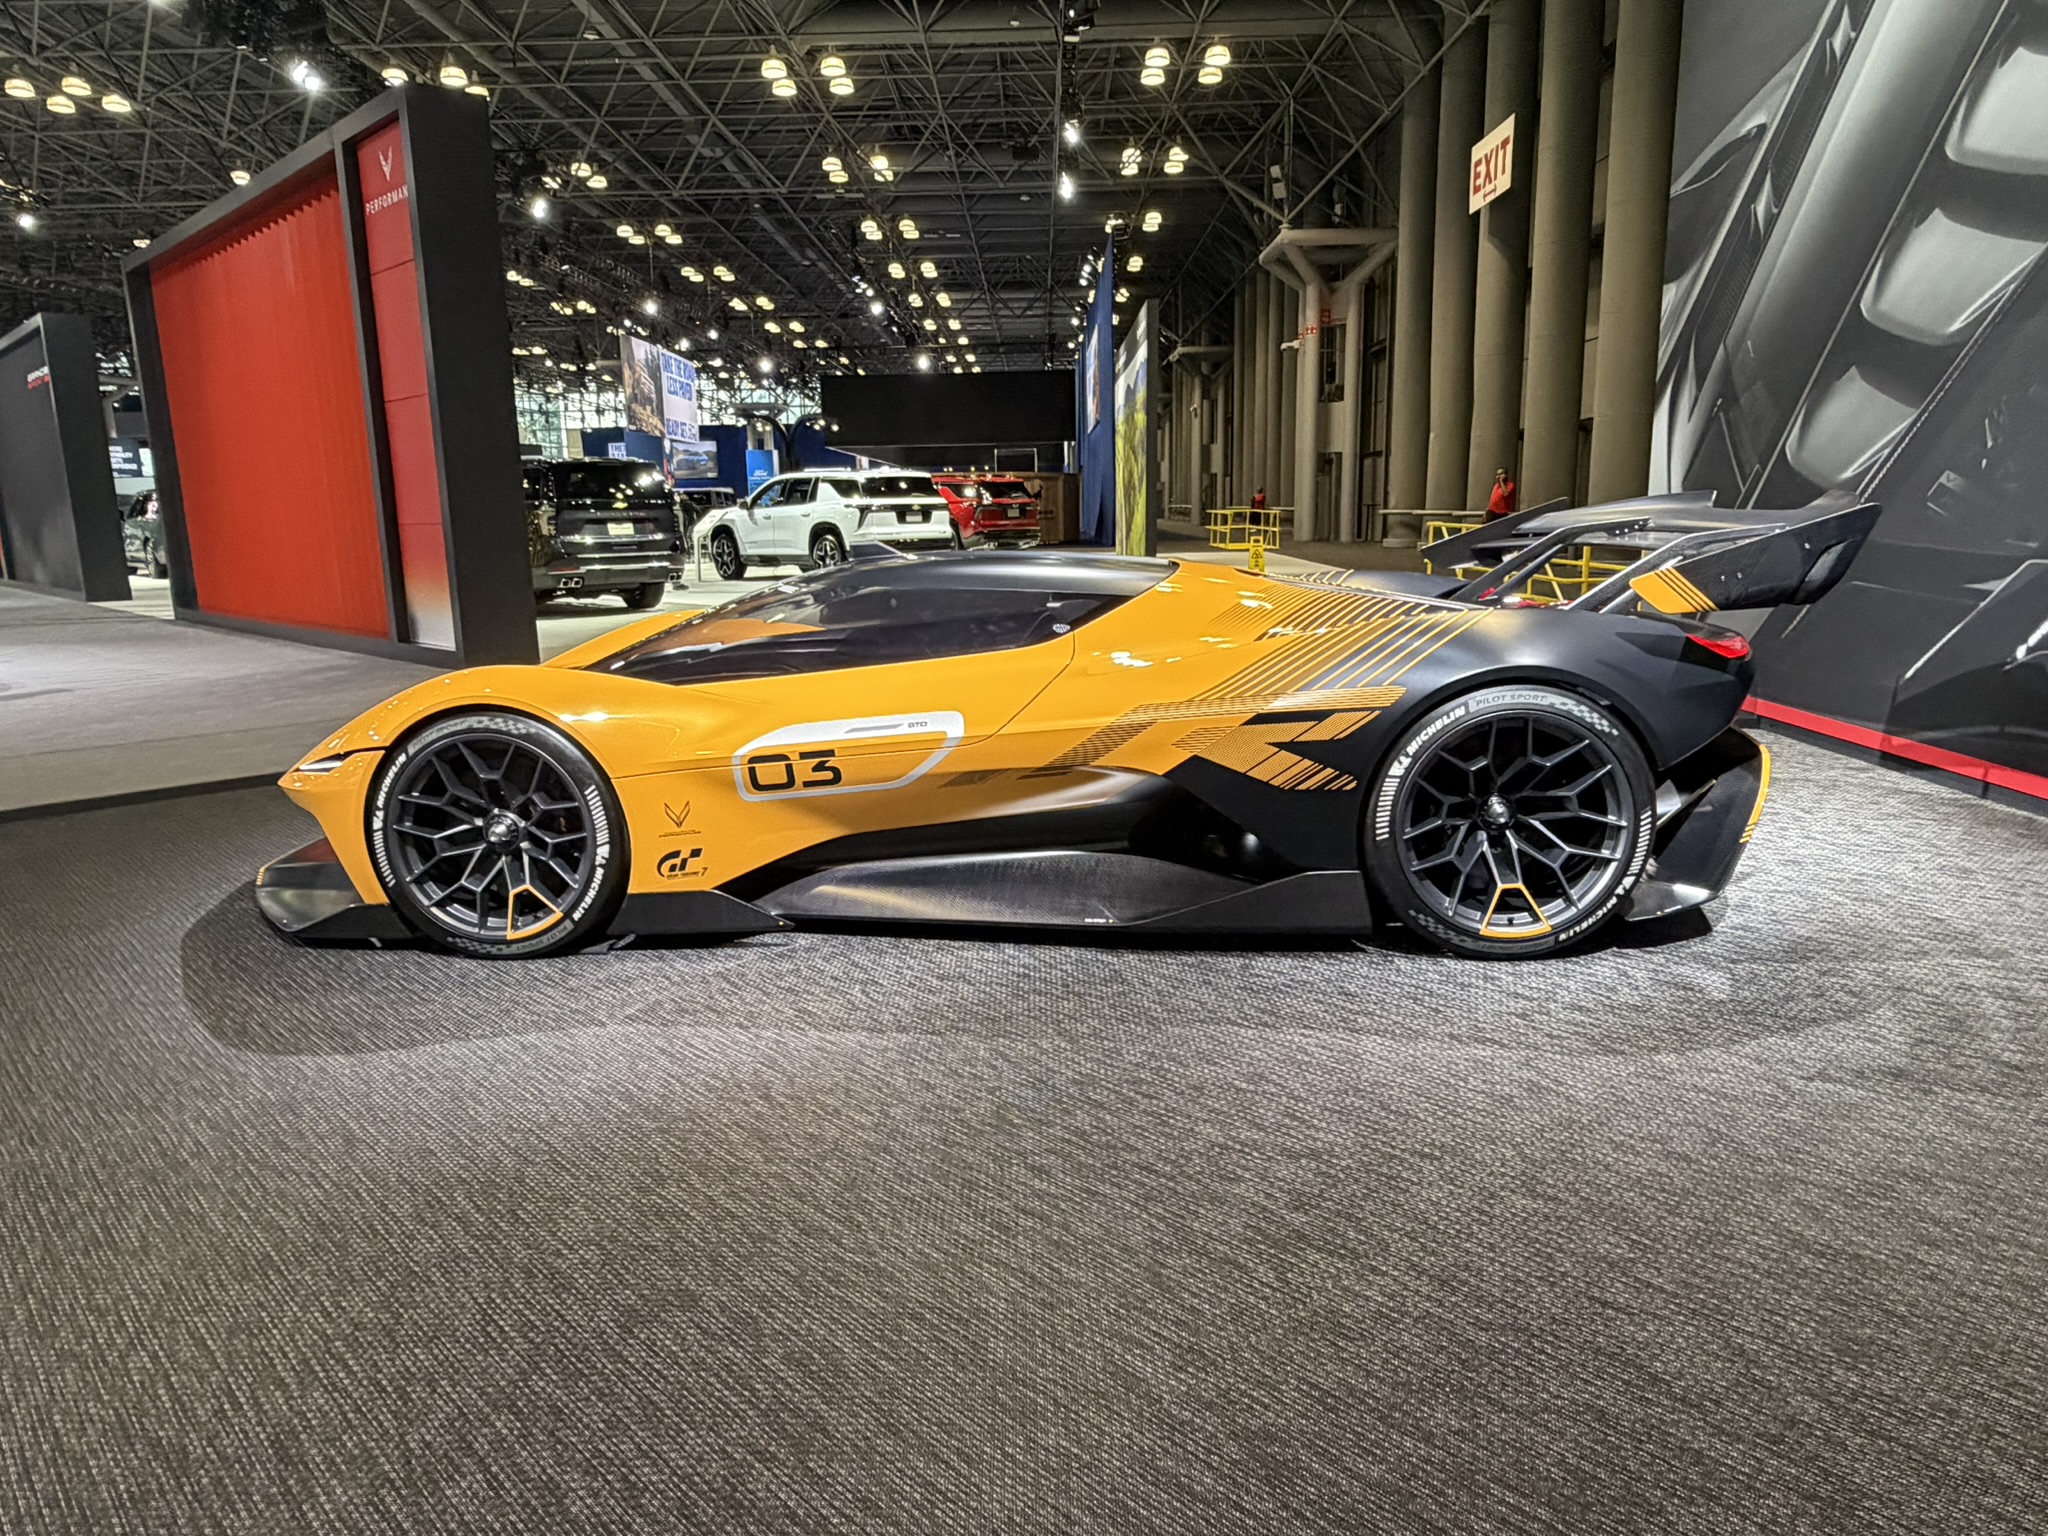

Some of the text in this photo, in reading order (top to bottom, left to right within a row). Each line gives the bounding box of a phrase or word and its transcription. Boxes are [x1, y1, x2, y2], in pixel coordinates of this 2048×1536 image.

[1473, 134, 1511, 196] EXIT
[666, 375, 678, 397] LESS
[1406, 693, 1547, 756] MICHELIN PILOT SPORT
[376, 752, 407, 809] MICHELIN
[747, 749, 842, 792] 03
[572, 866, 605, 922] MICHELIN
[1558, 896, 1618, 942] MICHELIN
